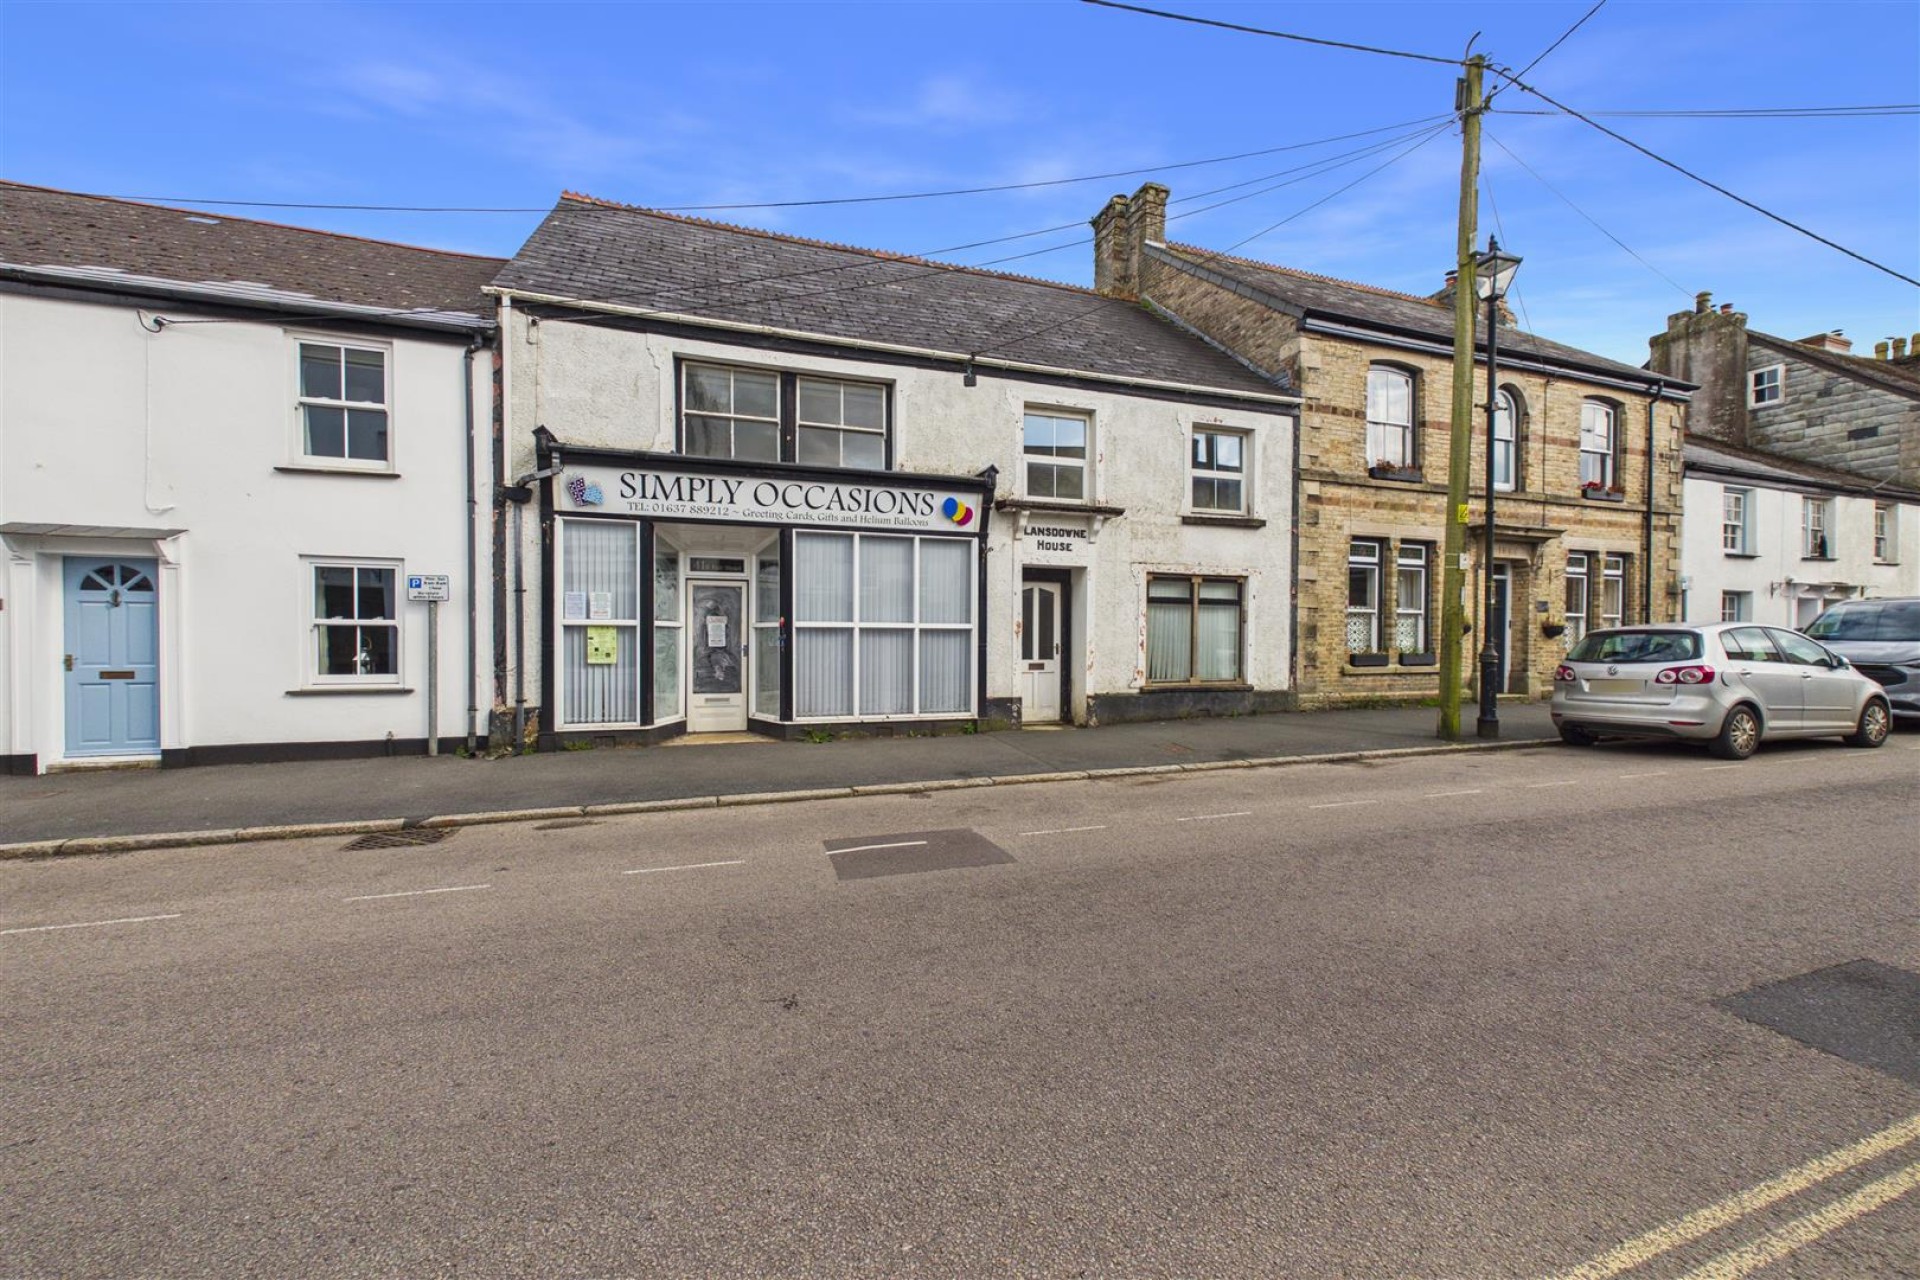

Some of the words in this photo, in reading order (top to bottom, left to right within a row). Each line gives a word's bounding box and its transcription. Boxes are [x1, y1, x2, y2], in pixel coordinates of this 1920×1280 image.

[620, 472, 744, 504] SIMPLY
[753, 482, 934, 516] OCCASIONS
[627, 501, 649, 512] TEL:
[652, 503, 687, 513] 01637
[689, 506, 729, 516] 889212
[742, 508, 783, 520] Greeting
[785, 511, 816, 522] Cards,
[817, 512, 838, 522] Gifts
[840, 513, 857, 523] and
[860, 515, 891, 525] Helium
[894, 517, 929, 527] Balloons
[1024, 525, 1087, 538] LANSDOWNE
[1037, 540, 1073, 551] HOUSE
